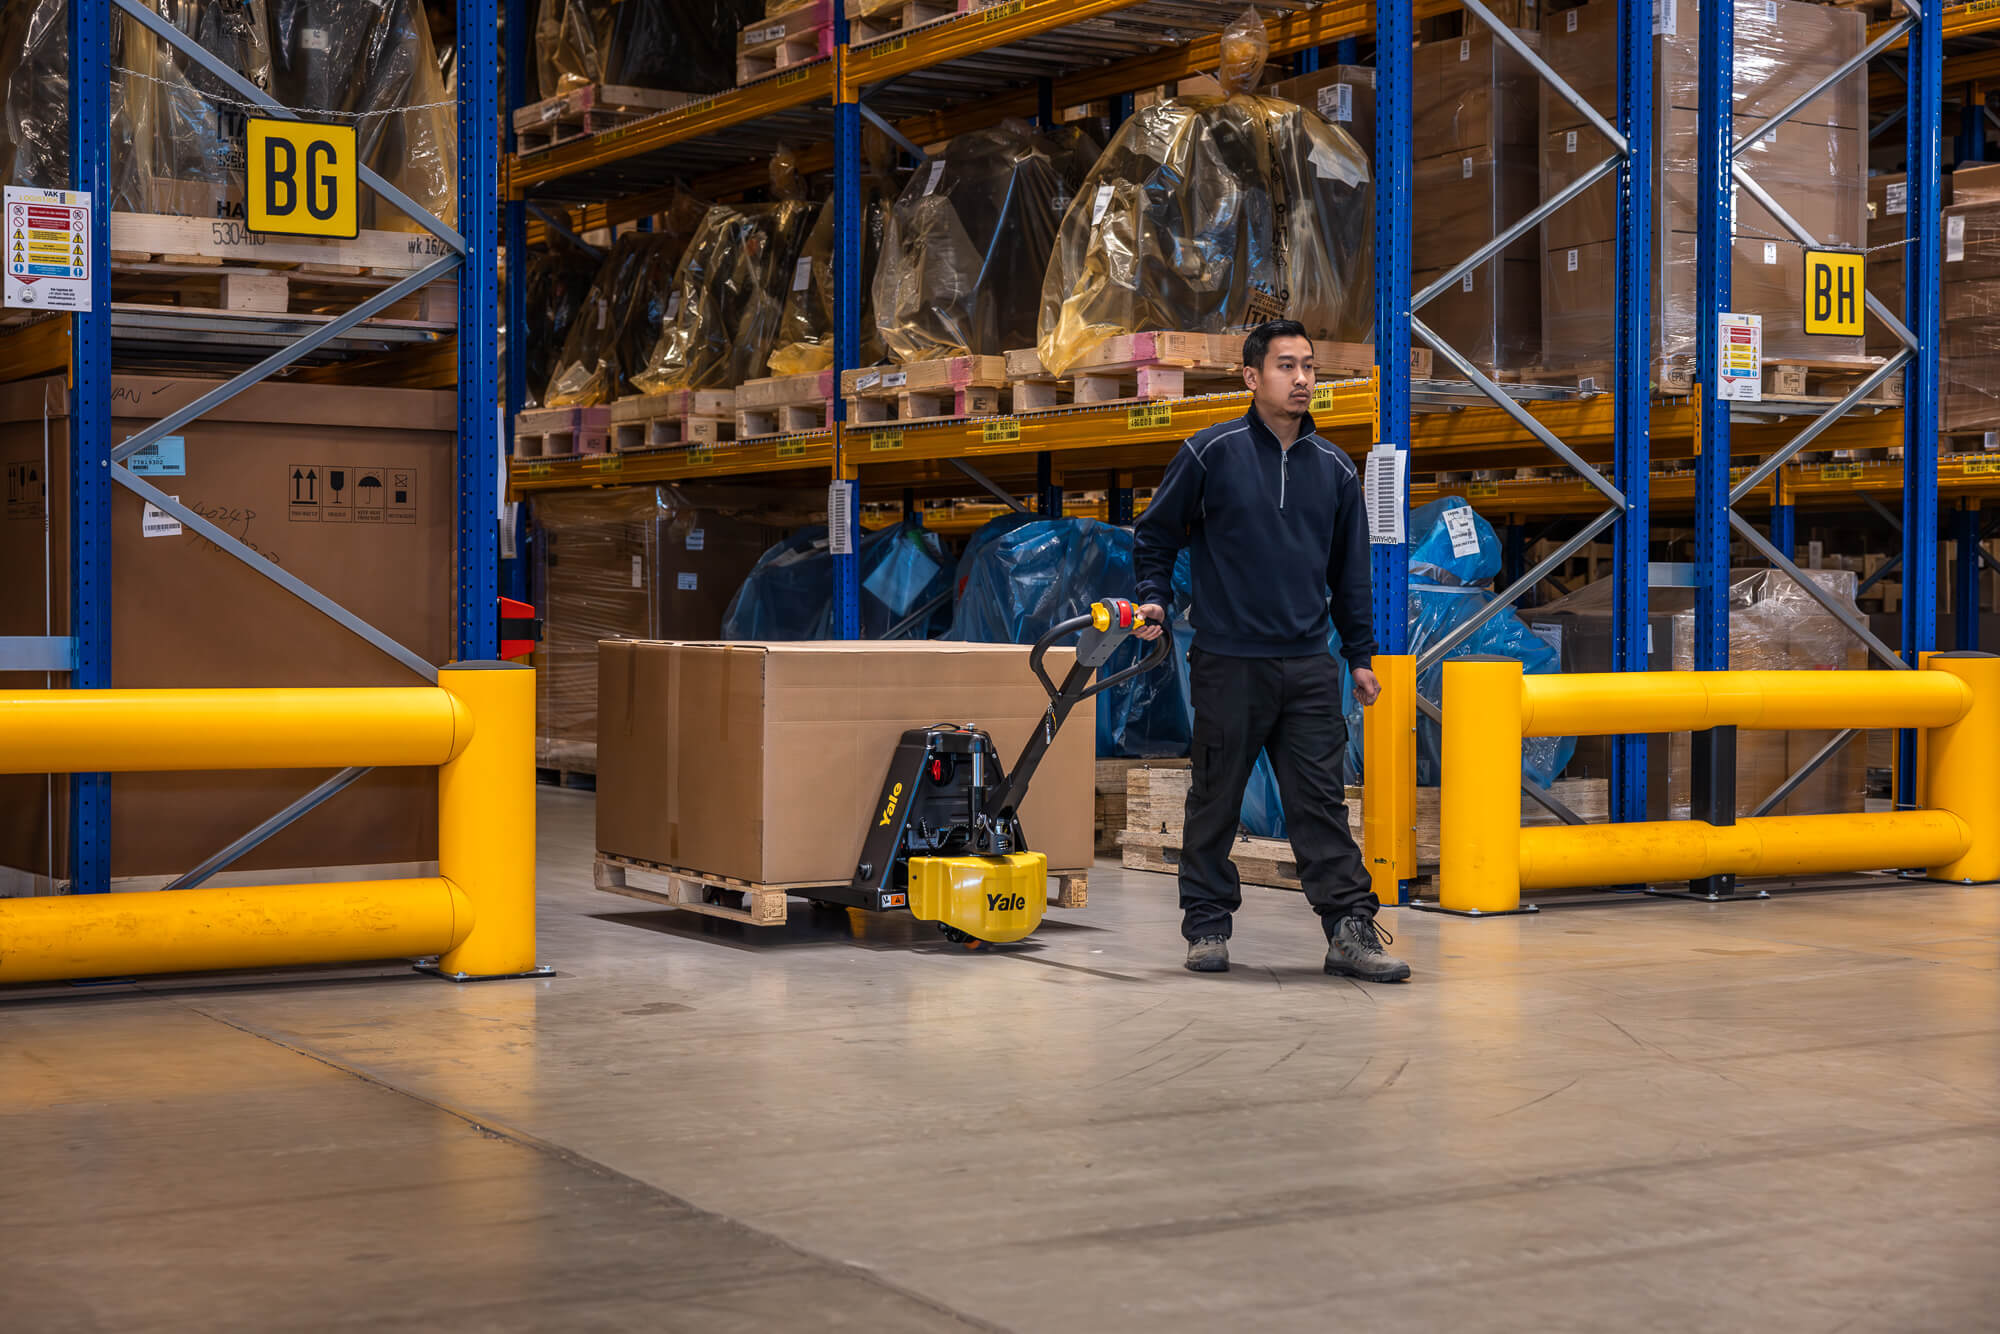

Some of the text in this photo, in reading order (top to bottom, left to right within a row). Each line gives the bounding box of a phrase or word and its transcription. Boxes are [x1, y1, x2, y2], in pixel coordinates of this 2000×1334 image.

[43, 190, 59, 198] VAK
[265, 136, 338, 221] BG
[1814, 263, 1856, 325] BH
[879, 782, 903, 826] Yale
[986, 892, 1026, 912] Yale
